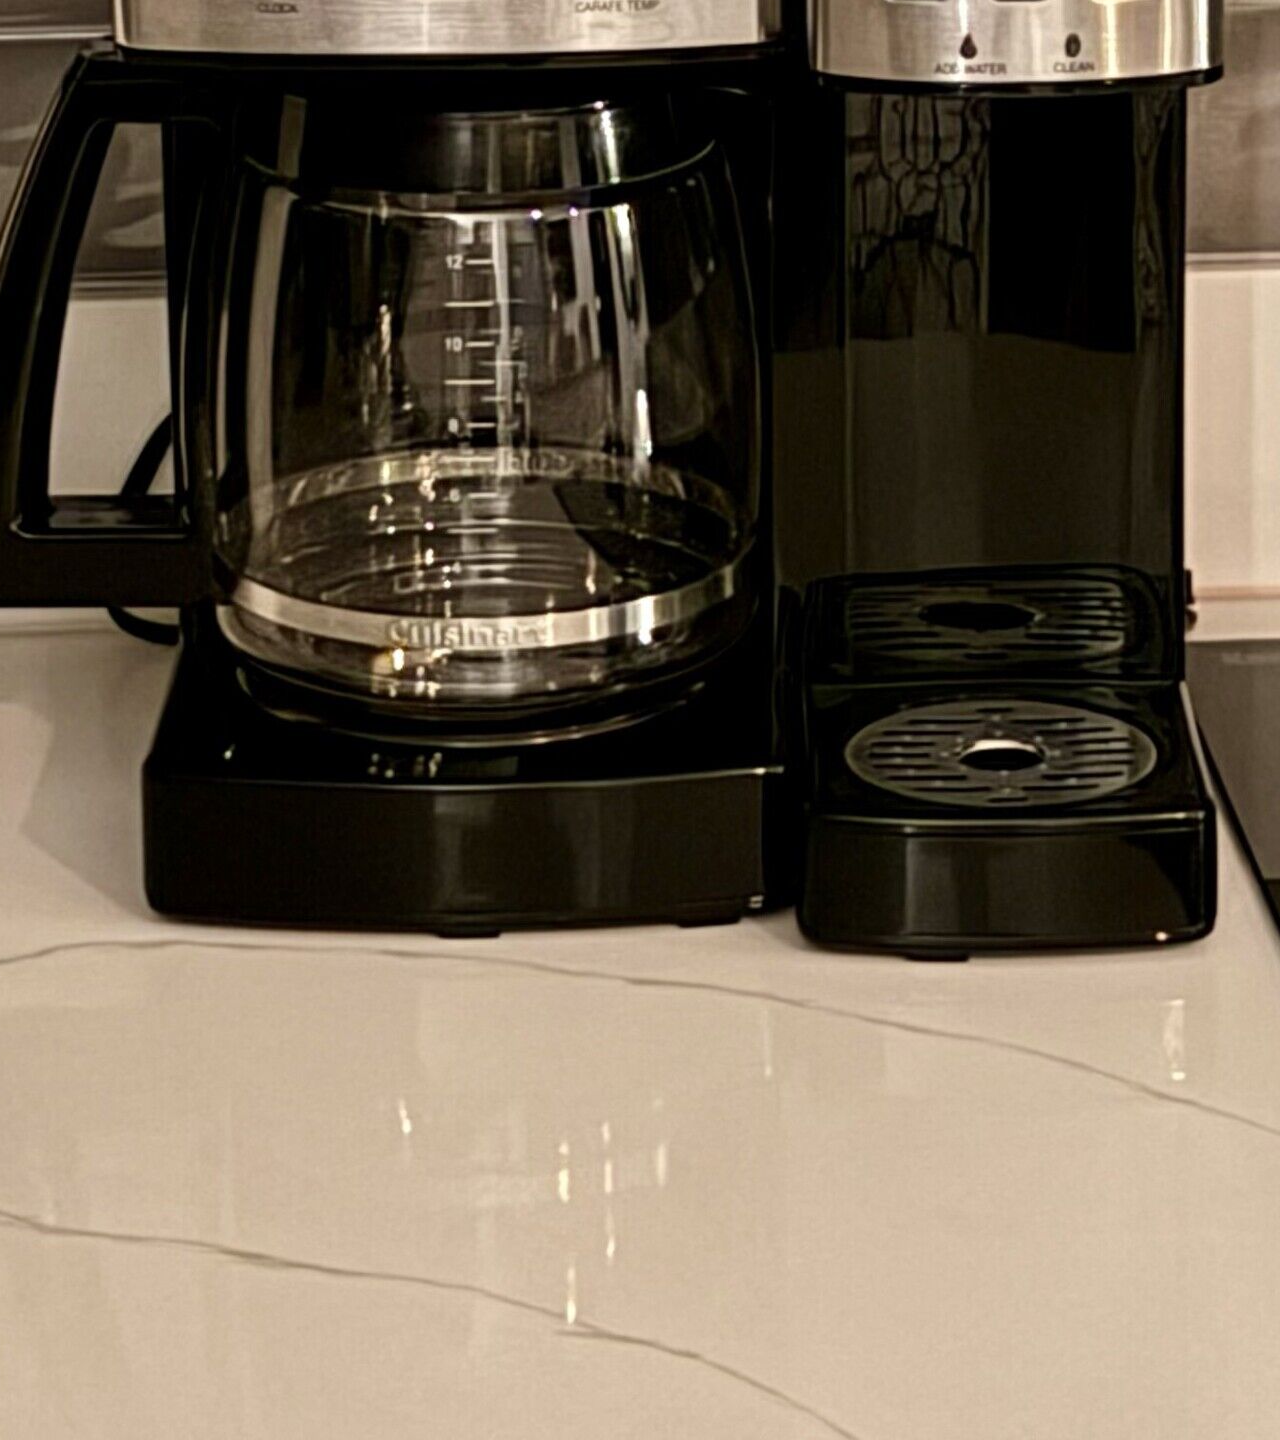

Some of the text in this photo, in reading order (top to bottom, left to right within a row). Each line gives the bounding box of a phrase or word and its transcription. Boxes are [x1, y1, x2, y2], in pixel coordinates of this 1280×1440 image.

[1053, 61, 1095, 73] CLEAN
[445, 253, 464, 270] 12
[444, 336, 463, 353] 10
